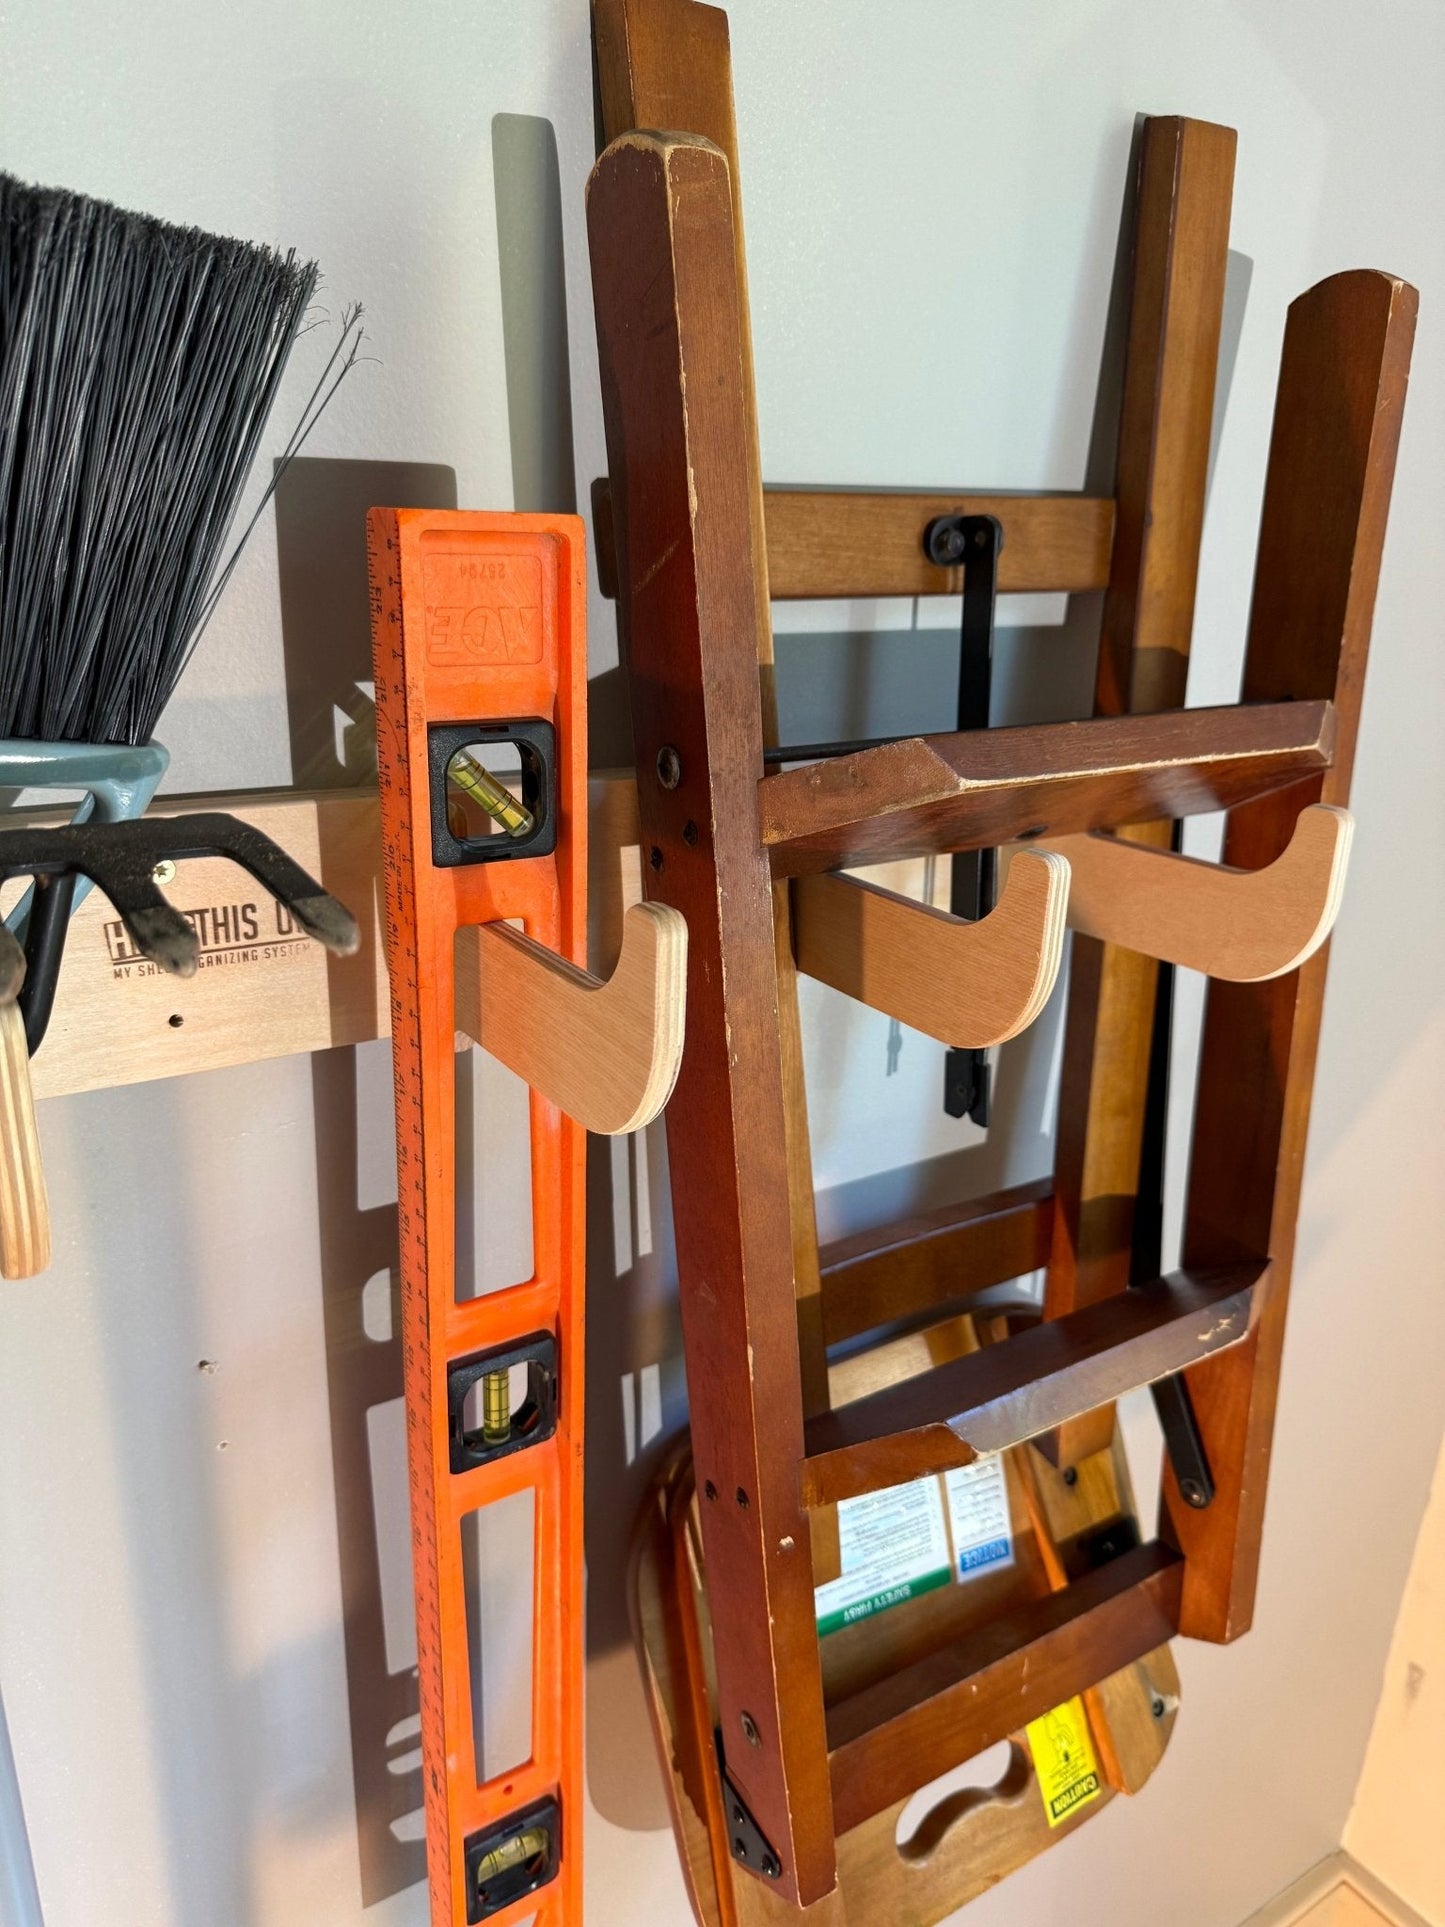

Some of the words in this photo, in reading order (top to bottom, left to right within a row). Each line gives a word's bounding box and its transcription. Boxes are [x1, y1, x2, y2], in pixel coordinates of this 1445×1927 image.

[195, 902, 259, 947] THIS
[275, 900, 304, 936] U
[113, 966, 132, 979] MY
[197, 948, 259, 969] GANIZING
[963, 1539, 1008, 1569] NOTICE
[842, 1597, 873, 1623] FIRST
[873, 1583, 912, 1609] SAFETY
[1053, 1775, 1097, 1816] CAUTION
